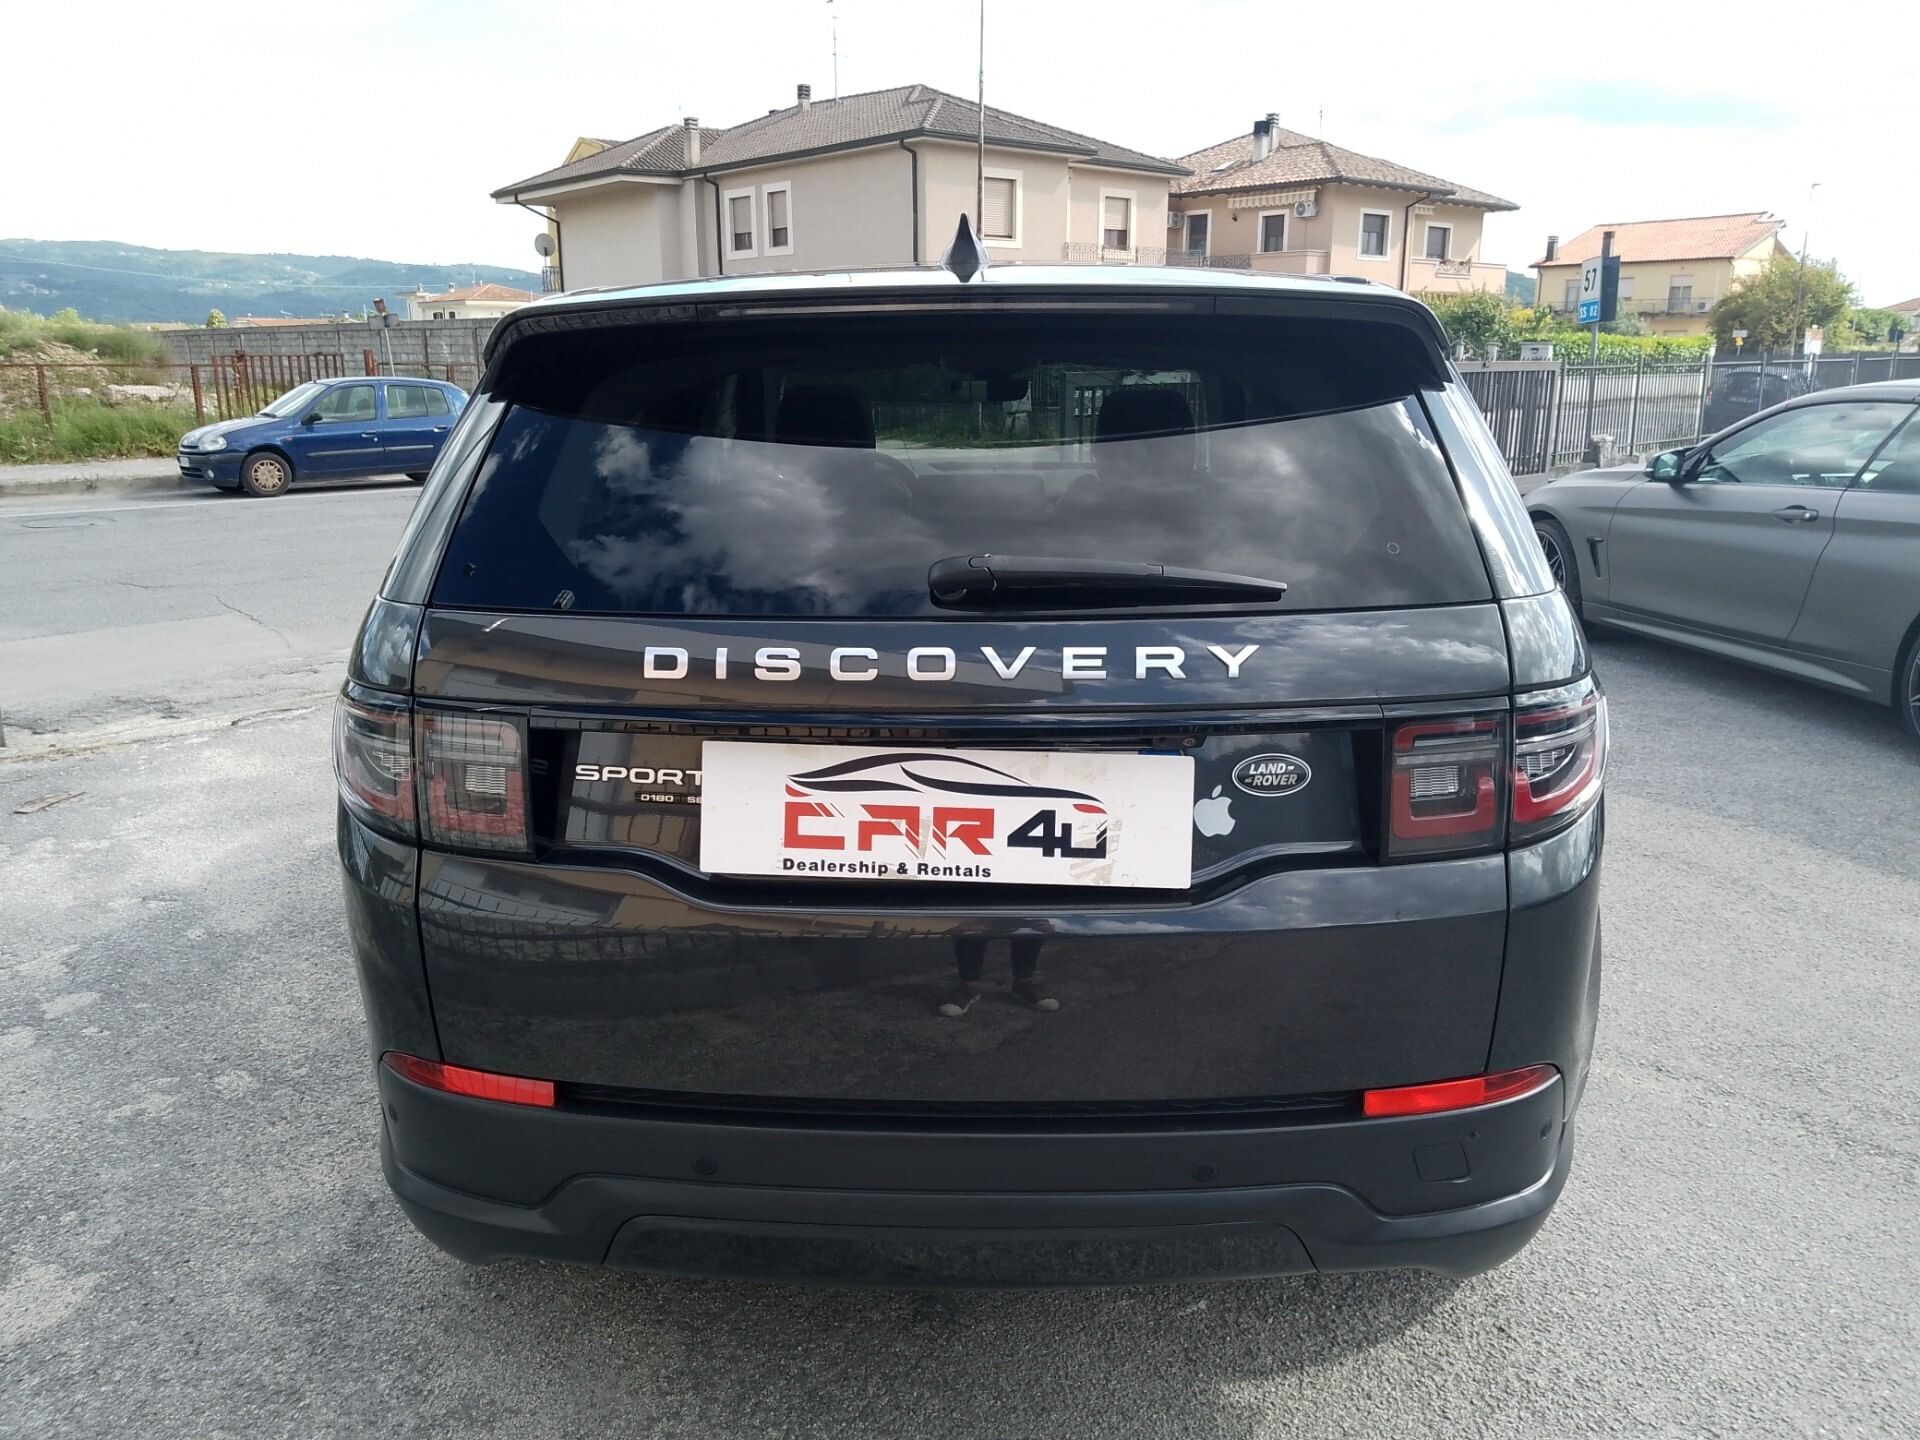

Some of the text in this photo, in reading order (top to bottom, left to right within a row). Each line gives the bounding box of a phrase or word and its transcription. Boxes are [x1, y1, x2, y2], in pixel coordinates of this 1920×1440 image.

[1584, 267, 1597, 292] 57
[643, 644, 1260, 681] DISCOVERY
[575, 764, 702, 786] SPORT
[1249, 762, 1286, 775] LAND
[1252, 773, 1298, 787] ROVER
[783, 801, 995, 858] CAR
[782, 857, 993, 879] Dealership & Rentals
